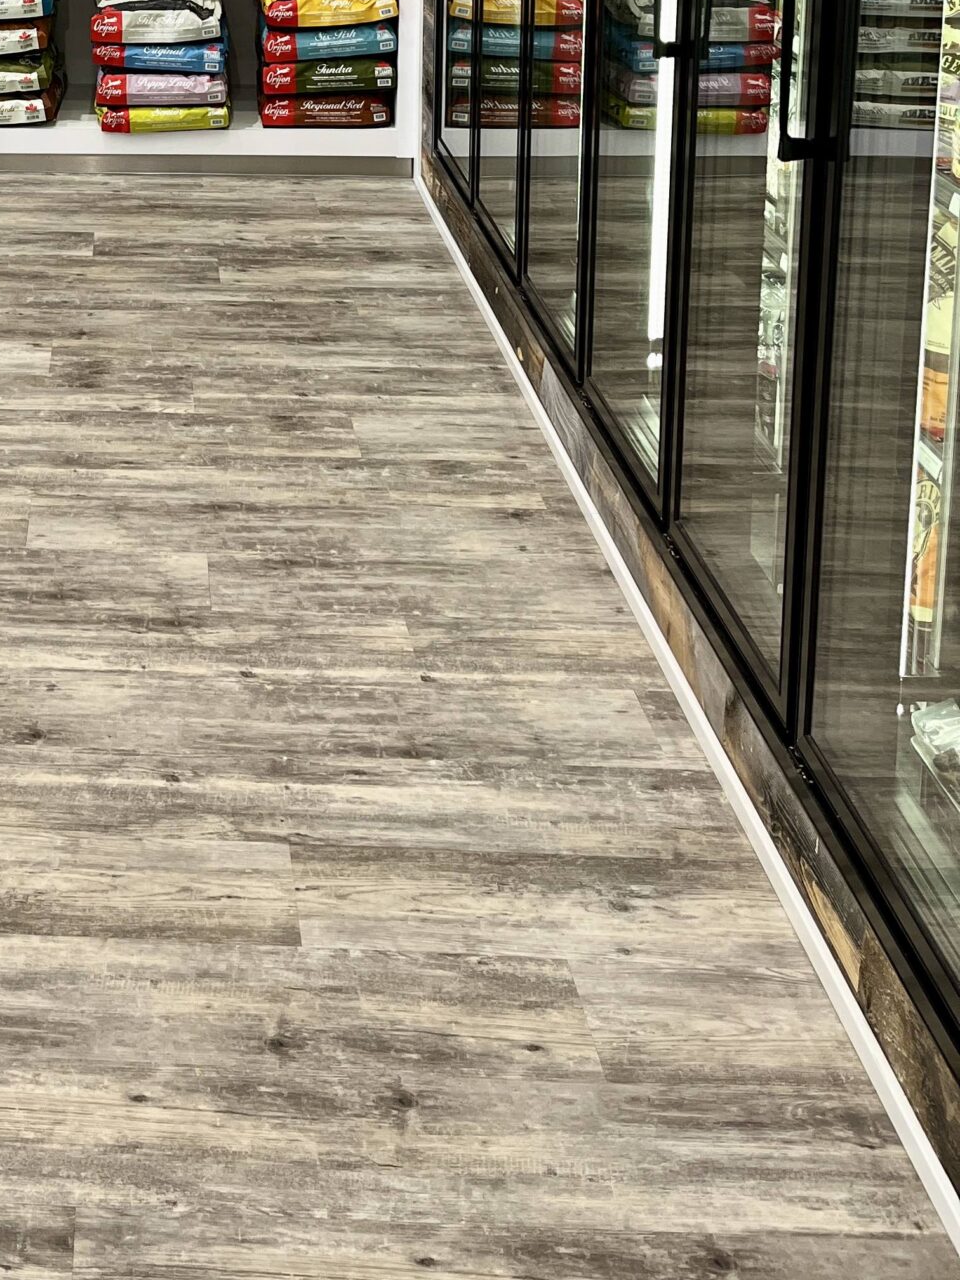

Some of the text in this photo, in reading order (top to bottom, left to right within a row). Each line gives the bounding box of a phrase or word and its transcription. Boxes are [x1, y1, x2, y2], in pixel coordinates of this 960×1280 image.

[268, 10, 293, 22] Orijen
[93, 20, 118, 37] Orijen
[315, 29, 357, 41] Six Fish
[96, 47, 120, 61] Orijen
[143, 46, 185, 58] Original
[315, 63, 353, 75] Tundra
[137, 78, 195, 92] Puppy Large
[300, 99, 364, 111] Regional Red
